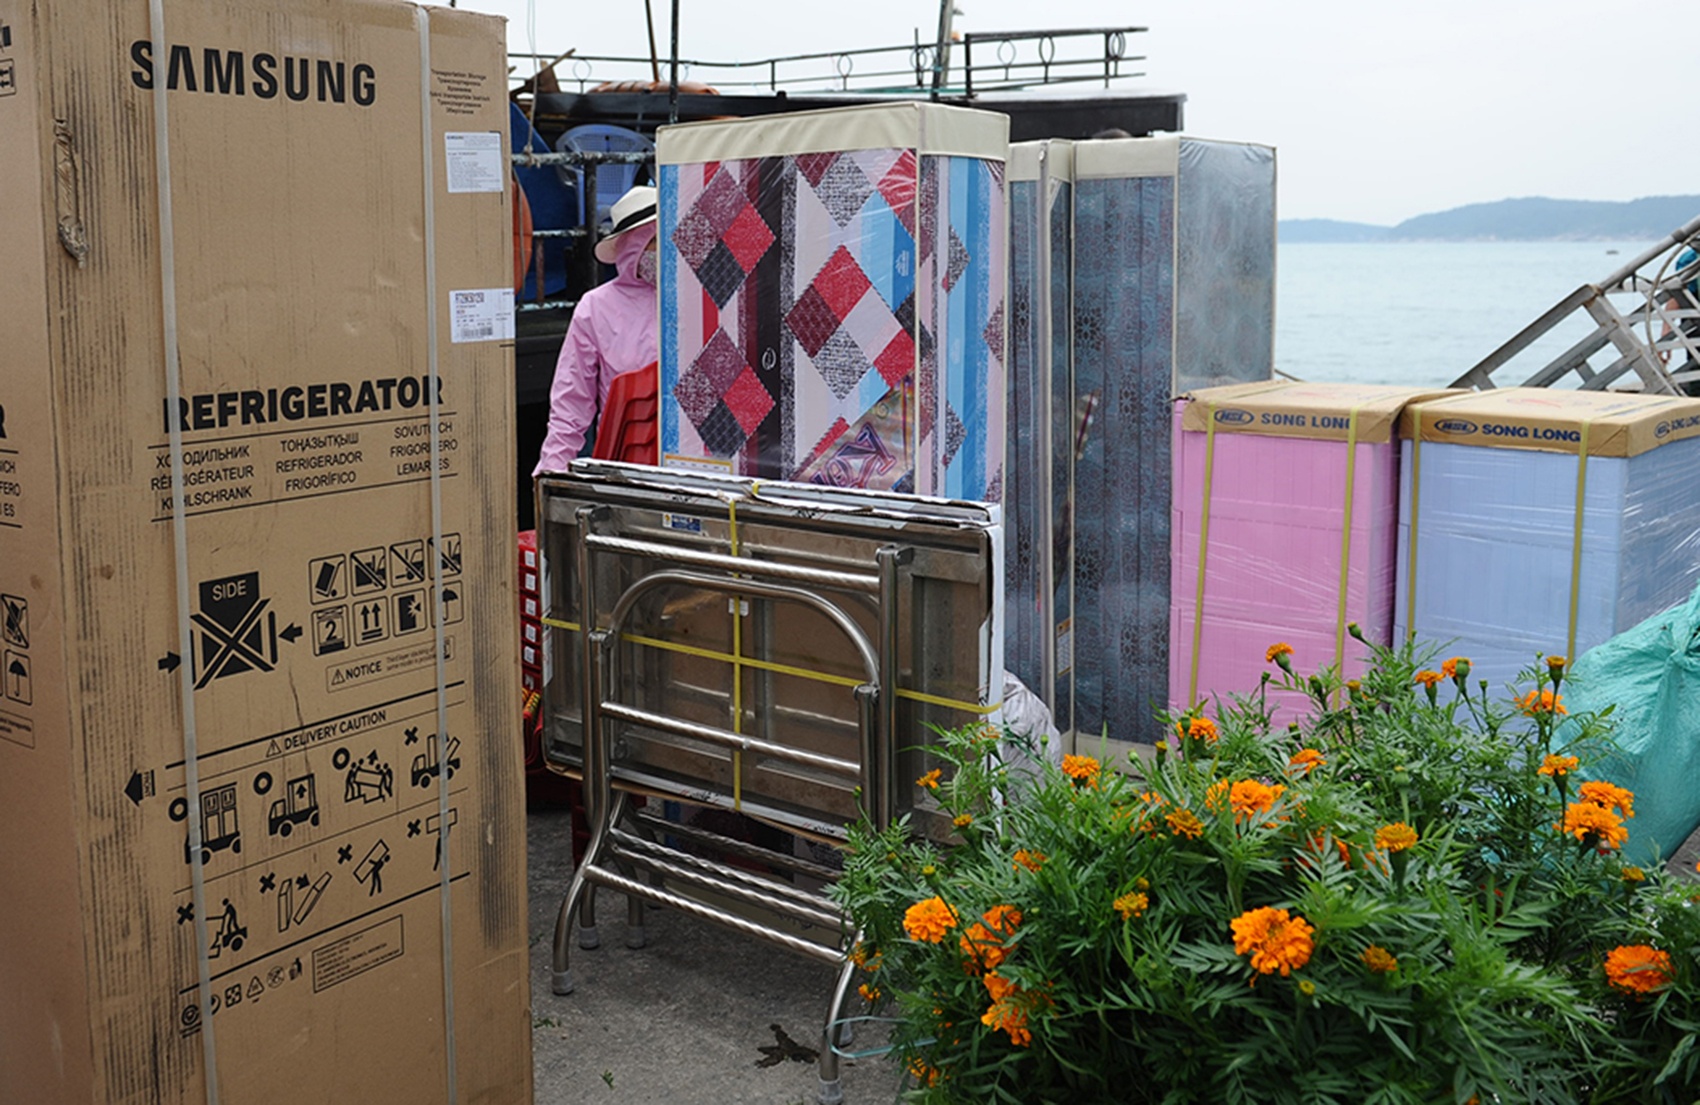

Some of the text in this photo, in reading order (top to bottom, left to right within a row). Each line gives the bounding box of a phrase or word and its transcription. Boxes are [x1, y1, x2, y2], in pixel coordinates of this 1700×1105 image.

[130, 40, 376, 106] SAMSUNG
[163, 375, 444, 434] REFRIGERATOR
[394, 422, 453, 439] SOVUTCH
[1261, 413, 1305, 427] SONG
[1482, 424, 1528, 438] SONG
[1533, 428, 1581, 442] LONG
[156, 445, 251, 469] ХООДИЛЬНИК
[390, 438, 458, 458] FRIGORIERO
[276, 451, 363, 473] REFRIGERADOR
[285, 471, 357, 492] FRIGORÍFICO
[211, 579, 247, 601] SIDE
[345, 660, 383, 680] NOTICE
[284, 710, 387, 750] DELIVERY CAUTION
